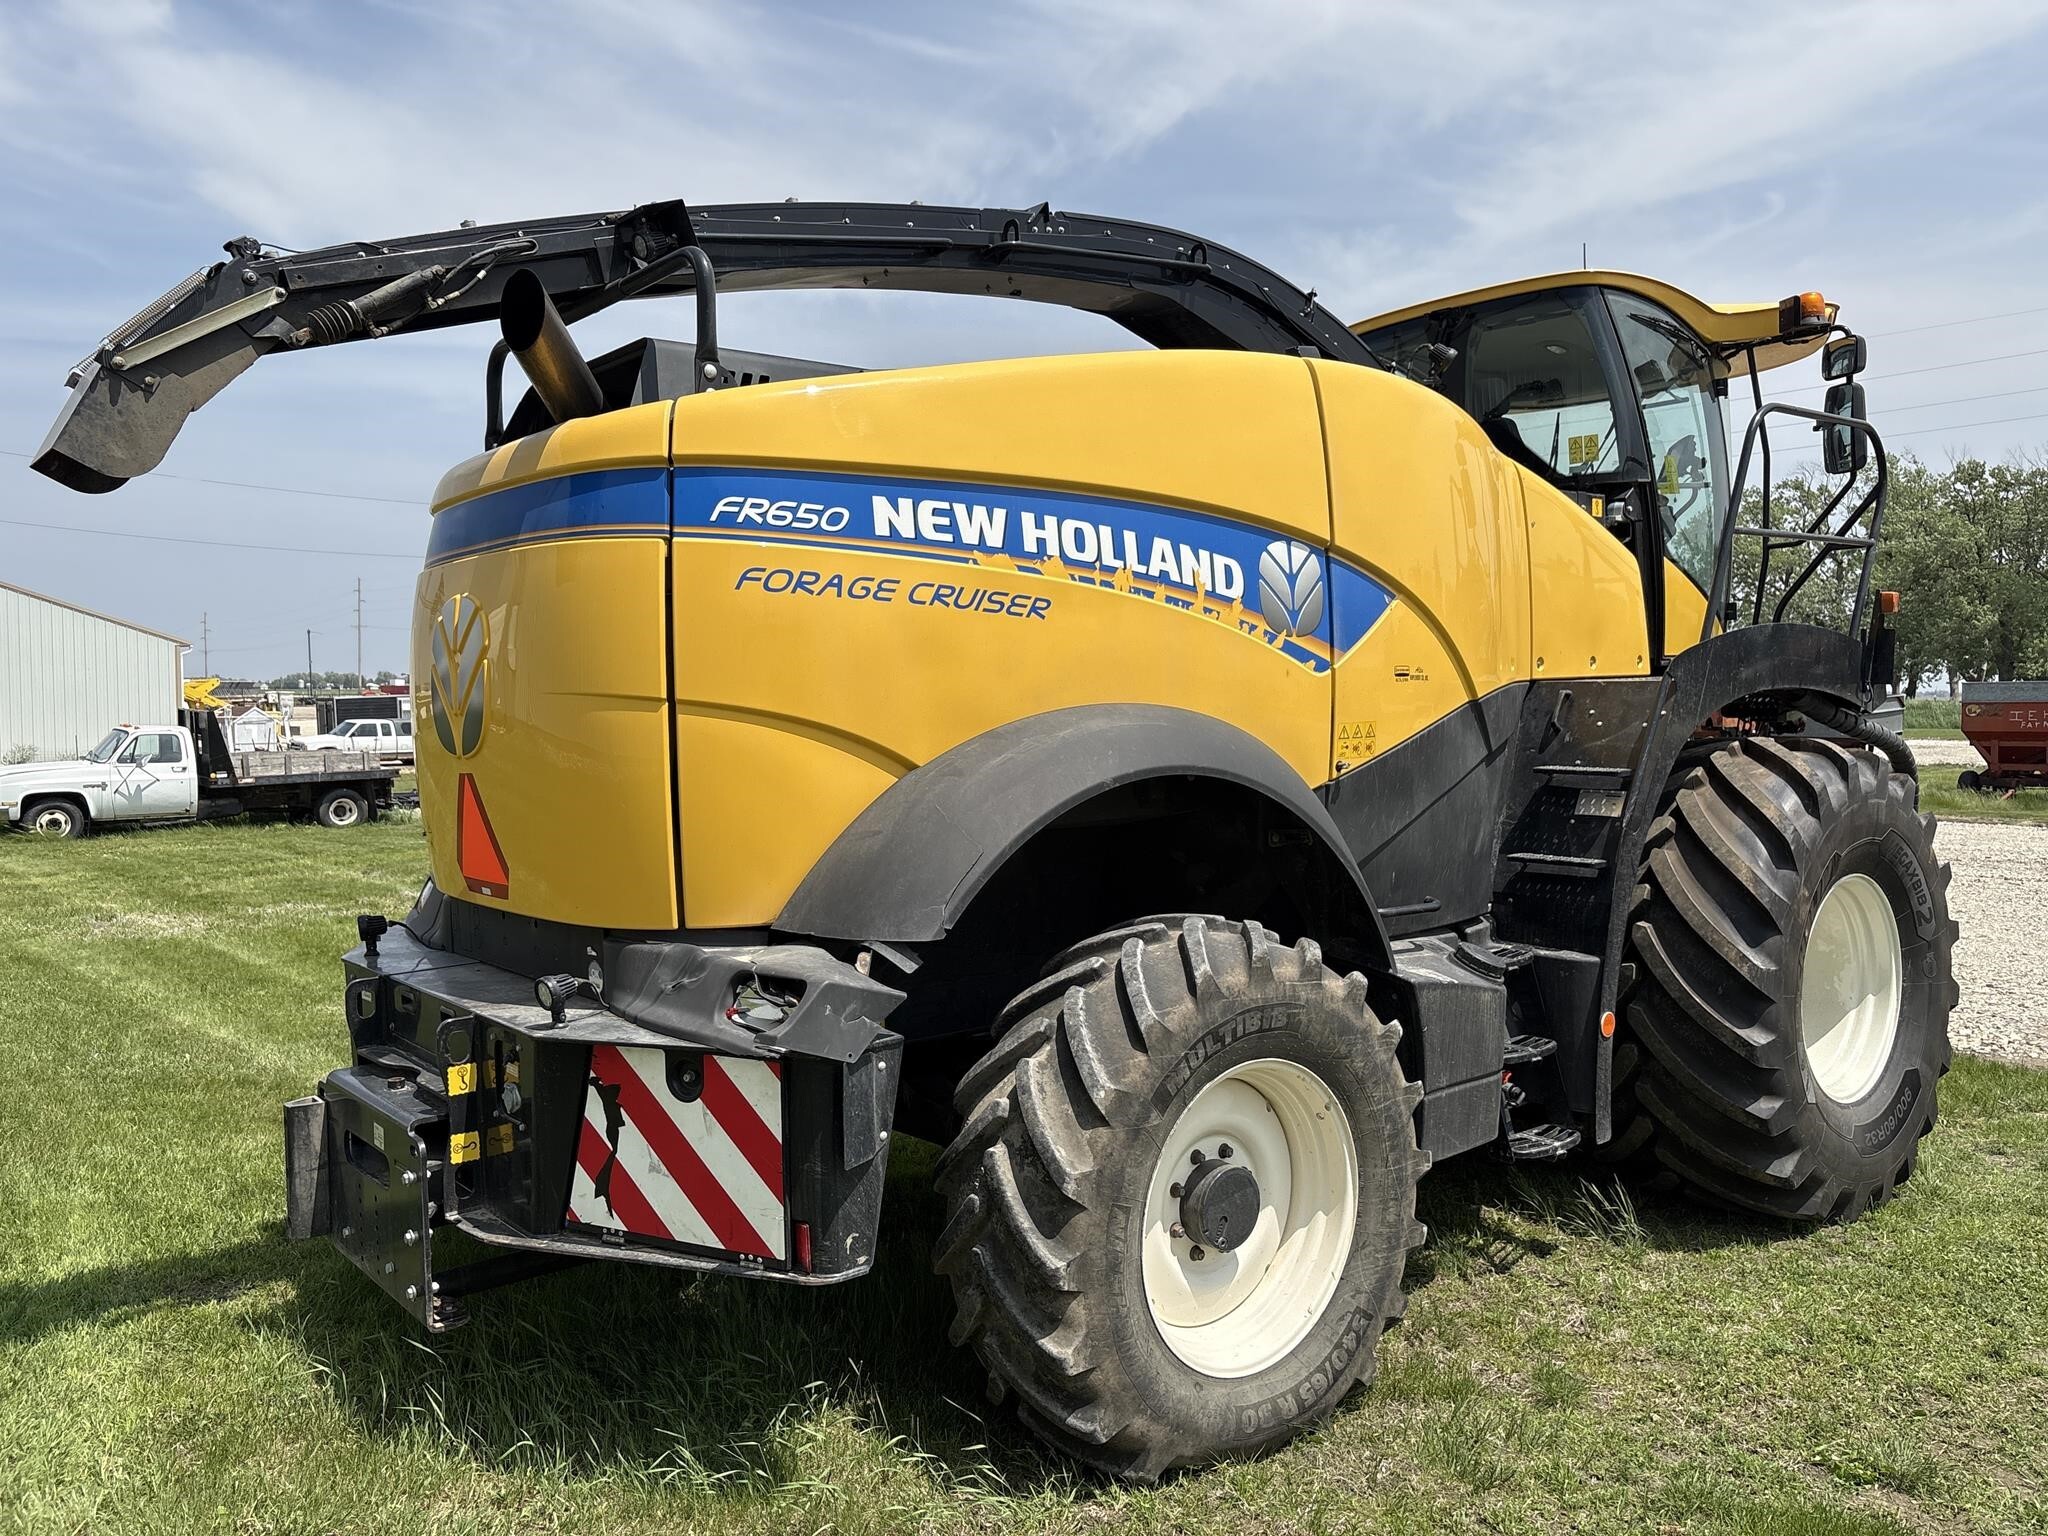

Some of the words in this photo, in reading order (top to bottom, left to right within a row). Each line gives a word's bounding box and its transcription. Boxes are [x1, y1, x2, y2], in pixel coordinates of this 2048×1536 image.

[709, 495, 850, 533] FR650
[872, 495, 1009, 549] NEW
[1021, 510, 1246, 600] HOLLAND
[733, 566, 902, 602] FORAGE
[907, 582, 1053, 621] CRUISER
[1887, 841, 1928, 908] MEGAXBIB
[1915, 905, 1934, 928] 2
[1863, 1086, 1913, 1147] 900/60R32
